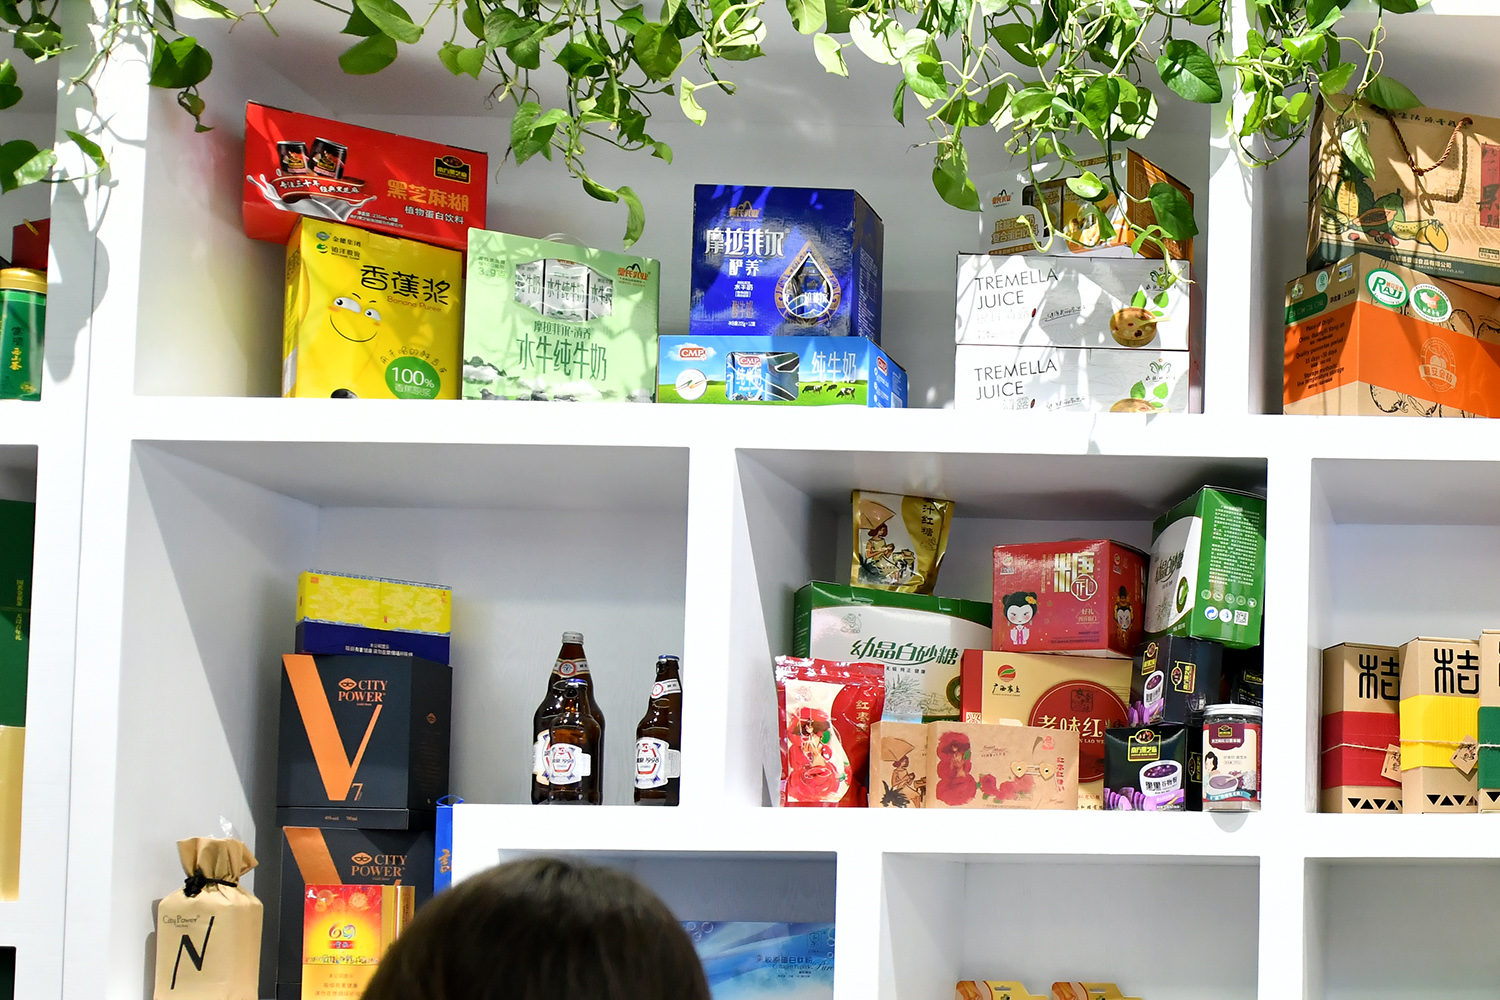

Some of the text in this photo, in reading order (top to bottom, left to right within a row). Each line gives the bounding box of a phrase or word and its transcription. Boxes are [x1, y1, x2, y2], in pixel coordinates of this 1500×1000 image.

[387, 178, 470, 213] 黑芝麻糊
[404, 205, 465, 225] 植物蛋白饮料
[704, 226, 785, 258] 摩拉菲尔
[360, 263, 452, 306] 香蕉浆
[974, 267, 1060, 291] TREMELLA
[386, 294, 443, 313] Banana Puree
[976, 289, 1026, 311] JUICE
[516, 332, 608, 382] 水牛纯牛奶
[680, 348, 705, 358] CMP
[740, 356, 760, 366] CMP
[391, 366, 435, 390] 100%
[811, 350, 858, 385] 纯牛奶
[973, 358, 1058, 383] TREMELLA
[975, 380, 1025, 402] JUICE
[850, 635, 960, 667] 幼晶白砂糖
[1358, 653, 1401, 700] 桔
[1433, 647, 1480, 695] 桔
[337, 690, 383, 703] POWER
[357, 679, 388, 691] CITY
[281, 653, 383, 801] V
[645, 756, 660, 764] 1998
[350, 865, 403, 878] POWER
[373, 854, 408, 866] CITY
[176, 914, 199, 925] Power
[170, 915, 216, 991] N
